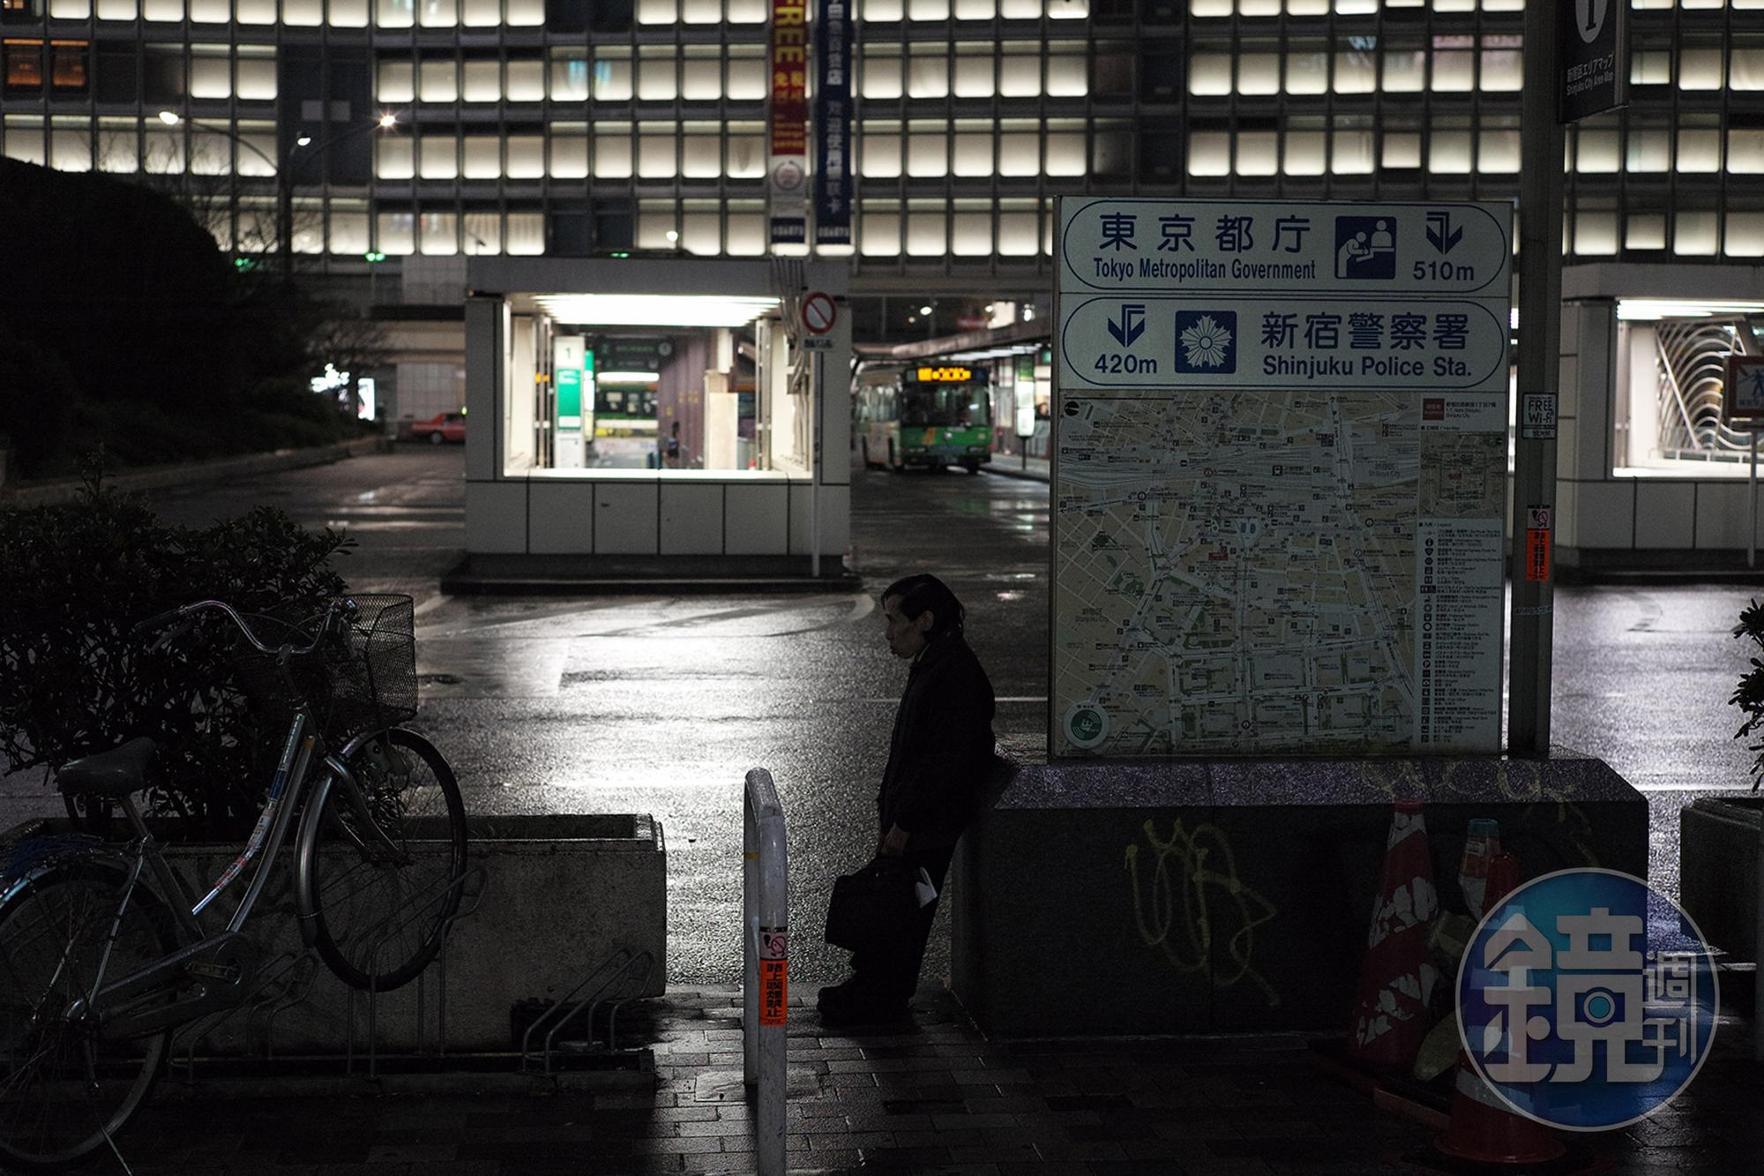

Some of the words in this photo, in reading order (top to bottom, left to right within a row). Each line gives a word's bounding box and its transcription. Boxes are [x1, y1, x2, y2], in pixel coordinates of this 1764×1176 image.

[774, 0, 804, 64] REE
[1099, 212, 1311, 254] 東京都庁
[1093, 257, 1134, 282] Tokyo
[1139, 257, 1226, 282] Metropolitan
[1231, 258, 1316, 282] Government
[1412, 260, 1475, 281] 510m
[1260, 312, 1470, 350] 新宿警察署
[1094, 354, 1158, 374] 420m
[1263, 354, 1354, 380] Shinjuku
[1361, 354, 1425, 377] Police
[1432, 355, 1472, 378] Sta.
[1528, 399, 1553, 412] FREE
